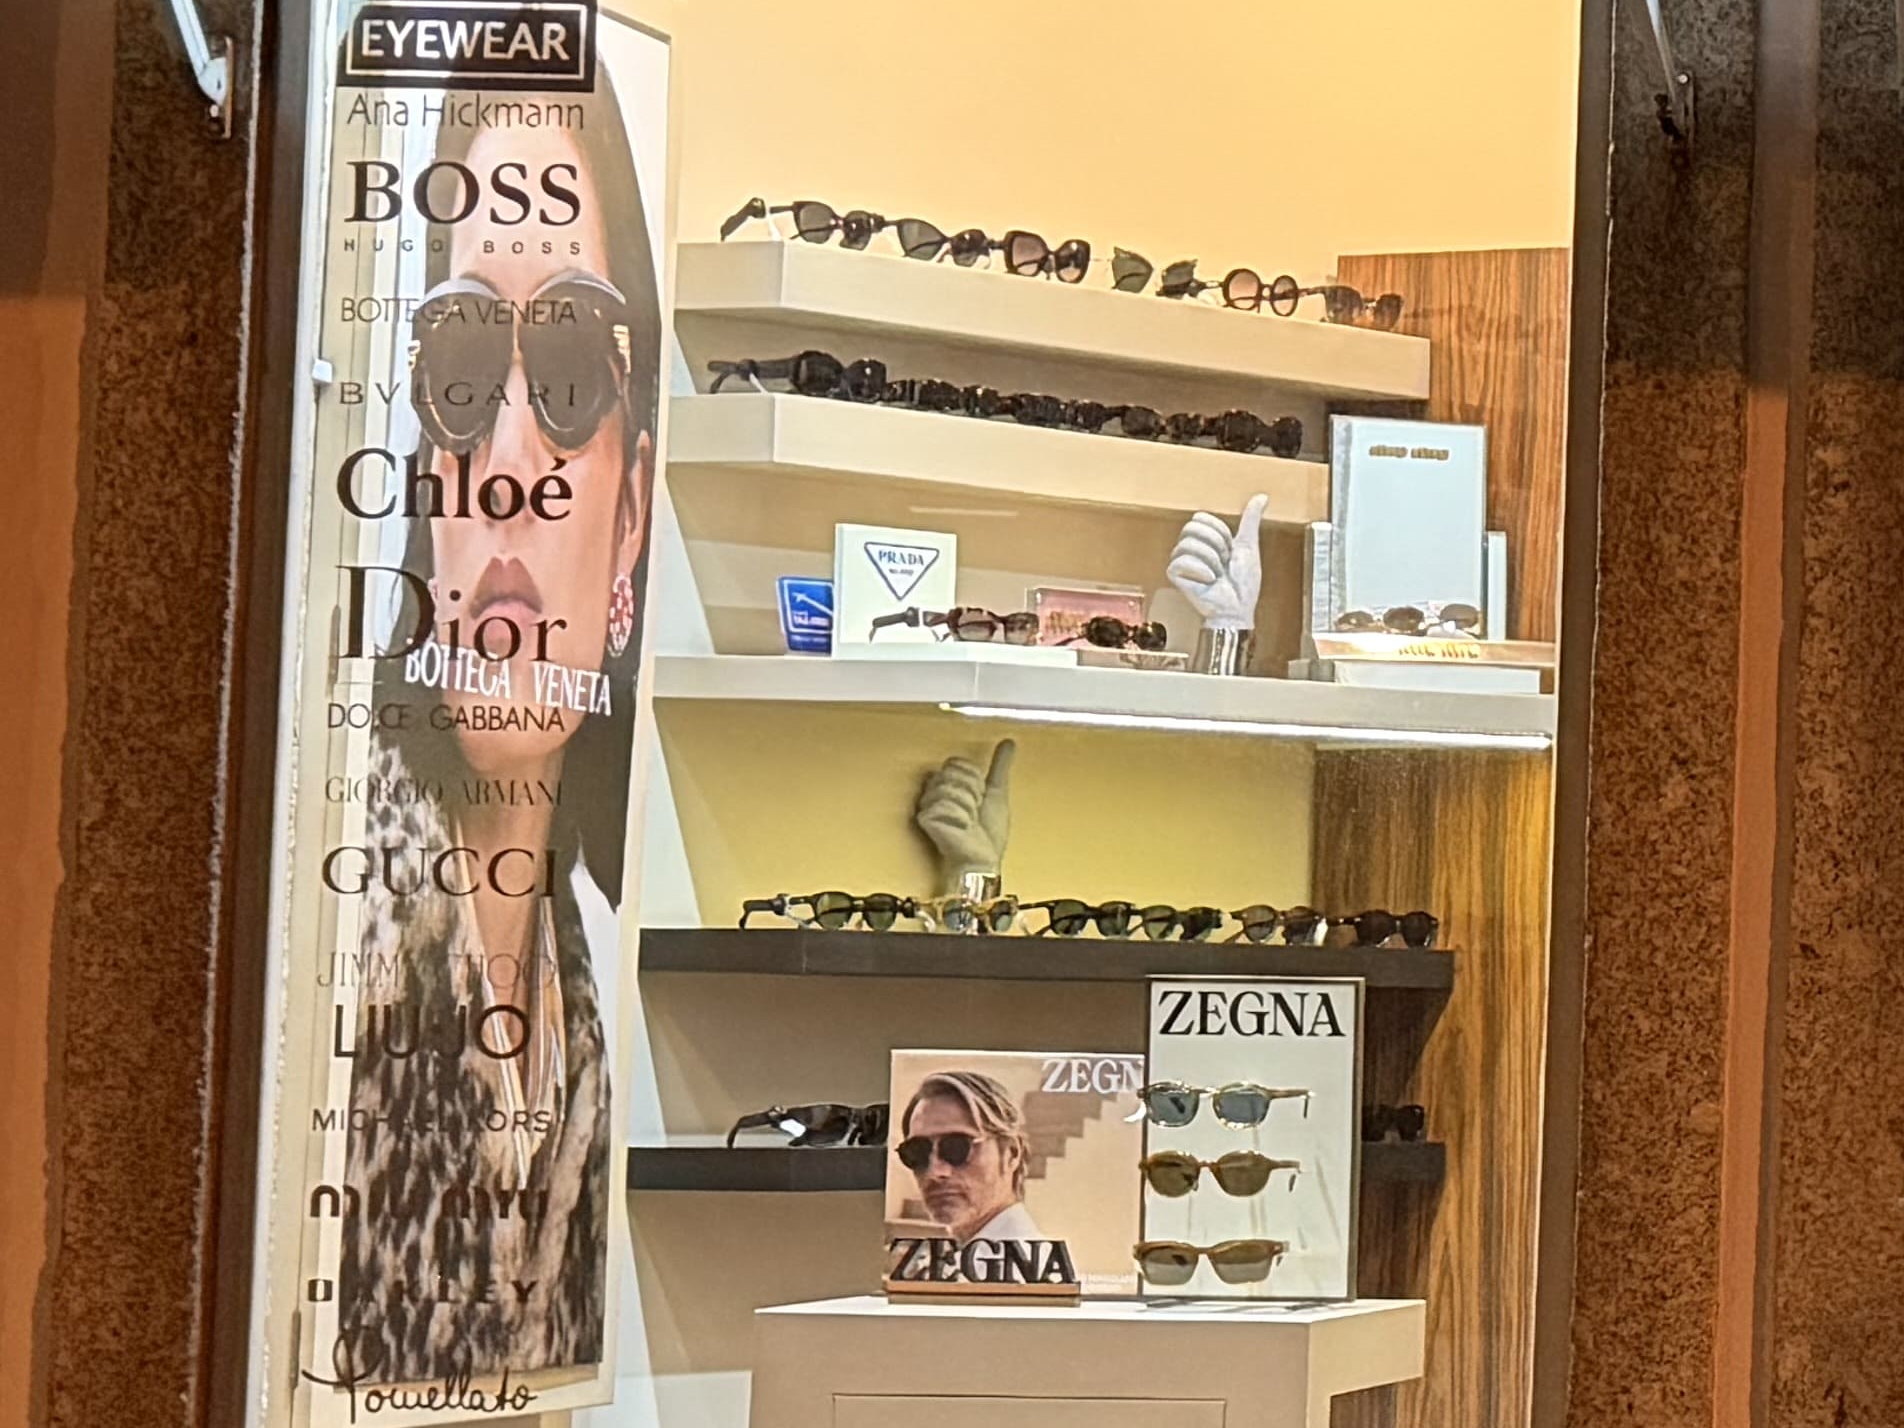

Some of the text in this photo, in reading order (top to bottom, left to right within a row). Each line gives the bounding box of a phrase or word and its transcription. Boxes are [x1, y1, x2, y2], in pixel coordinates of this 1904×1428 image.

[360, 17, 571, 61] EYEWEAR
[346, 93, 585, 131] Ana Hickmann
[344, 158, 582, 227] BOSS
[344, 238, 581, 255] HUGO BOSS
[341, 298, 577, 326] BOTTEGA VENETA
[335, 446, 574, 521] Chloé
[878, 549, 924, 566] PRADA
[335, 565, 568, 662] Dior
[405, 638, 612, 716] BOTTEGA VENETA
[430, 704, 566, 732] GABBANA
[325, 776, 563, 807] GIORGIO ARMANI
[322, 846, 556, 898] GUCCI
[1158, 990, 1346, 1038] ZEGNA
[887, 1237, 1079, 1284] ZEGNA
